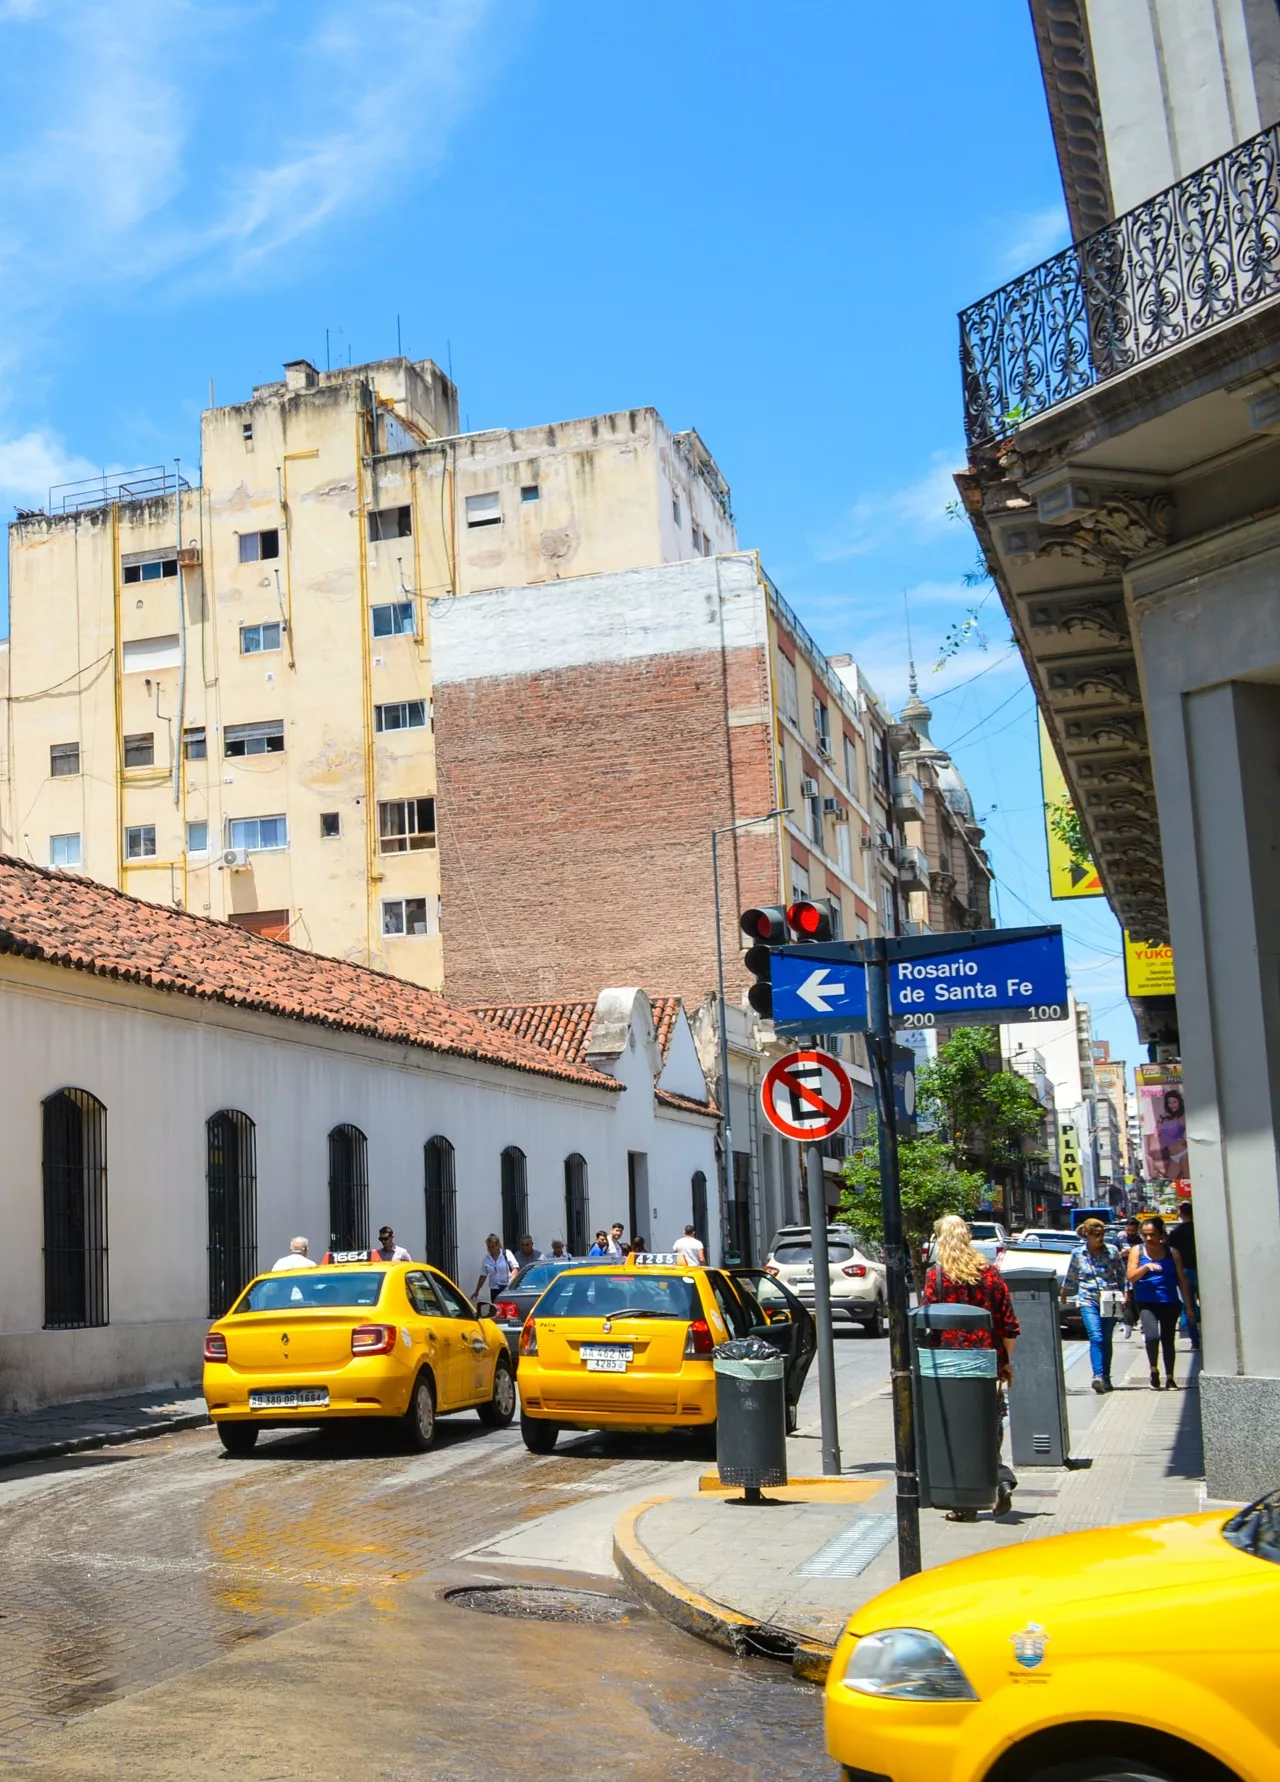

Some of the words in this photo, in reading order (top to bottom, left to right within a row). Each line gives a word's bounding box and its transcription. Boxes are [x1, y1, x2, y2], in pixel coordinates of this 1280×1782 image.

[898, 959, 978, 980] Rosario
[899, 986, 925, 1004] de
[935, 982, 998, 1001] Santa
[1007, 979, 1033, 997] Fe
[1028, 1005, 1062, 1020] 100
[903, 1013, 935, 1028] 200
[1062, 1125, 1079, 1192] PLAYA
[332, 1251, 368, 1263] 1664
[636, 1253, 674, 1264] 4285
[597, 1348, 616, 1359] 462
[595, 1360, 617, 1369] 4285
[300, 1394, 321, 1403] 1664
